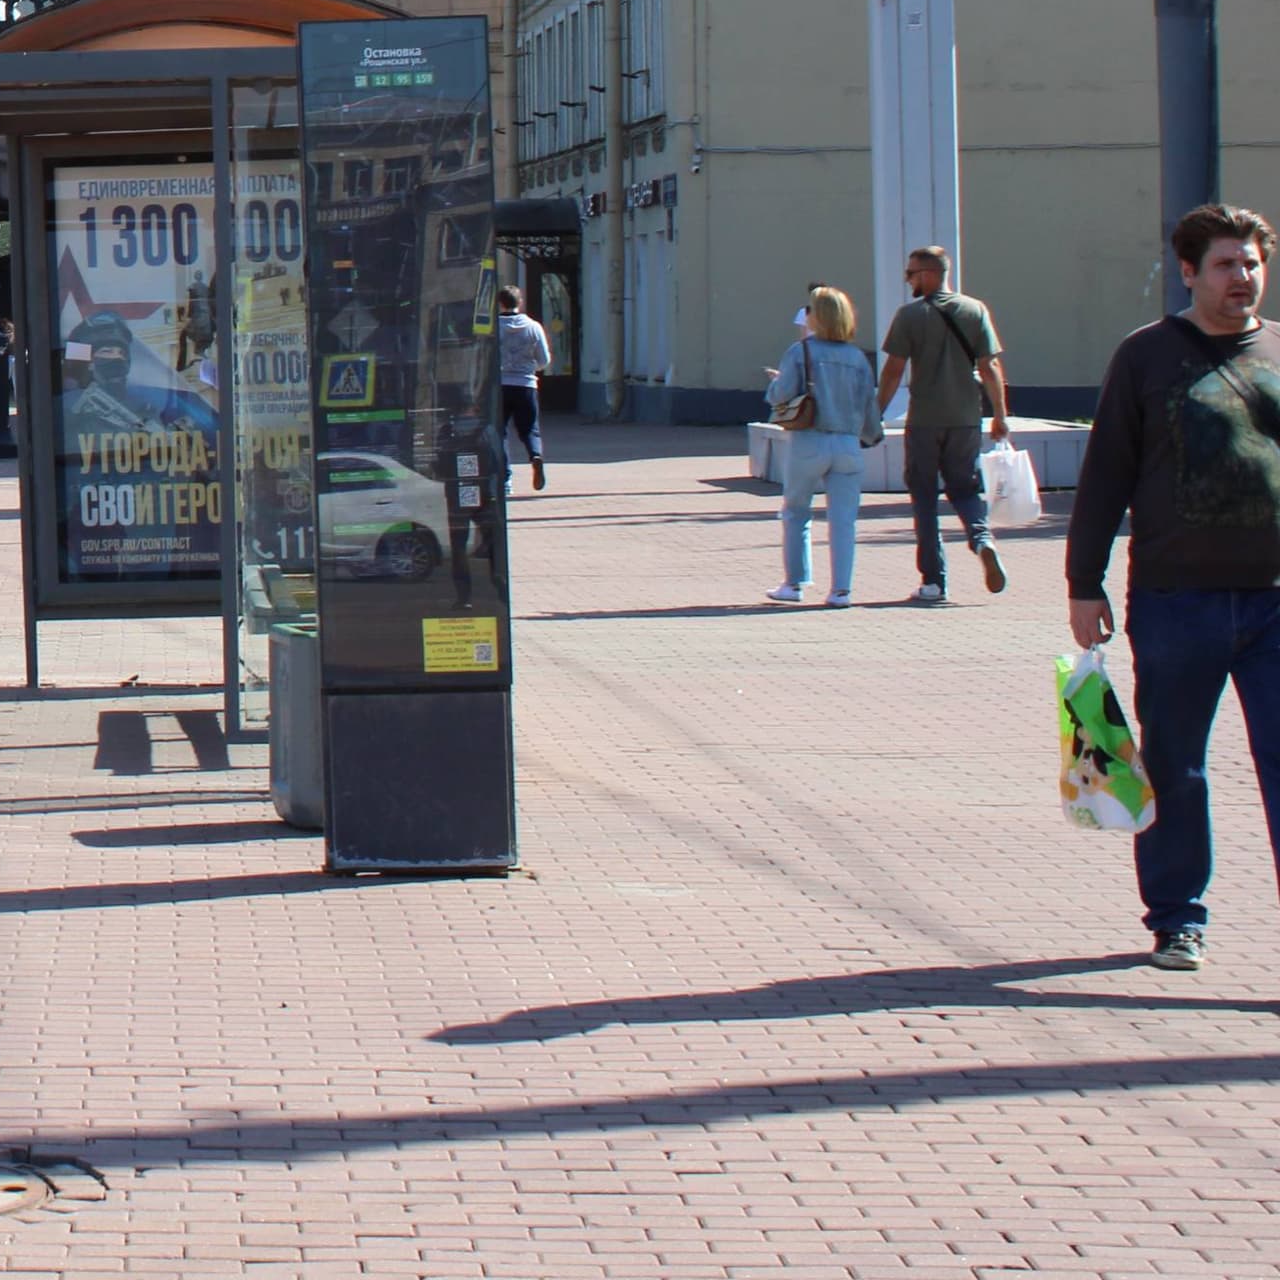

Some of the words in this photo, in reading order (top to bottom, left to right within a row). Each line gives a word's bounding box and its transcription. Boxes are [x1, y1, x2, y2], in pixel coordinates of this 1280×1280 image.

[364, 48, 422, 58] Остановка
[78, 178, 216, 200] ЕДИНОВРЕМЕННАЯ
[79, 207, 99, 268] 1
[112, 203, 199, 268] 300
[78, 433, 95, 474] У
[80, 483, 153, 527] СВОИ
